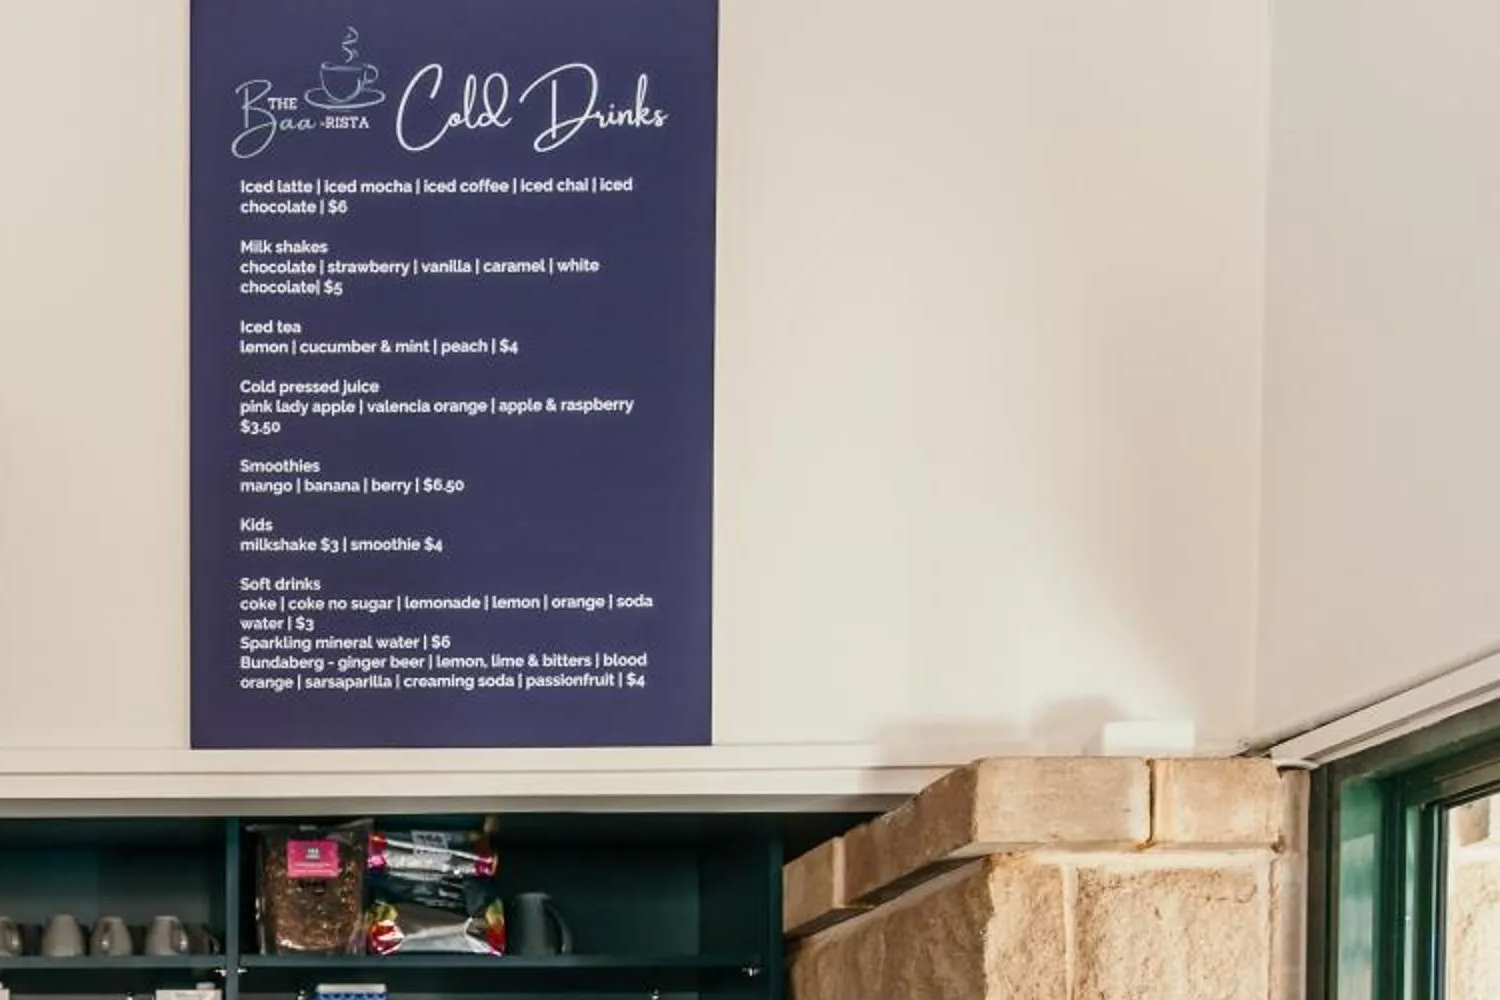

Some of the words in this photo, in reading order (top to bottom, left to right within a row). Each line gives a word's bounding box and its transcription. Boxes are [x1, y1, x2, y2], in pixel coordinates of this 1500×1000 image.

[267, 97, 298, 110] THE
[396, 63, 512, 151] Cold
[519, 63, 669, 153] Drinks
[240, 179, 275, 194] Iced
[276, 179, 314, 194] latte
[323, 179, 358, 194] iced
[359, 179, 413, 193] mocha
[423, 178, 458, 193] iced
[459, 178, 511, 193] coffee
[519, 177, 554, 193] iced
[555, 177, 590, 192] chai
[599, 177, 634, 192] iced
[239, 199, 318, 214] chocolate
[327, 198, 349, 215] $6
[240, 239, 273, 254] Milk
[275, 239, 329, 254] shakes
[238, 259, 317, 274] chocolate
[326, 259, 412, 277] strawberry
[419, 259, 474, 273] vanilla
[481, 258, 547, 273] caramel
[555, 257, 601, 272] white
[239, 320, 274, 334] Iced
[276, 320, 302, 334] tea
[239, 339, 289, 354] lemon
[298, 339, 378, 354] cucumber
[379, 339, 393, 353] &
[394, 339, 431, 353] mint
[440, 338, 489, 357] peach
[499, 337, 519, 355] $4
[239, 379, 277, 394] Cold
[278, 379, 341, 397] pressed
[340, 379, 381, 397] juice
[239, 418, 282, 435] $3.50
[239, 458, 322, 473] Smoothies
[239, 481, 294, 496] mango
[303, 478, 361, 493] banana
[370, 478, 413, 495] berry
[422, 477, 465, 494] $6.50
[239, 517, 274, 532] Kids
[239, 537, 318, 552] milkshake
[319, 536, 340, 553] $3
[349, 537, 422, 551] smoothie
[423, 536, 444, 552] $4
[239, 577, 273, 591] Soft
[273, 576, 322, 591] drinks
[239, 617, 285, 630] water
[294, 615, 315, 632] $3
[239, 636, 313, 653] Sparkling
[314, 635, 375, 649] mineral
[374, 636, 421, 649] water
[430, 634, 452, 649] $6
[239, 677, 295, 693] orange
[304, 674, 394, 692] sarsaparilla
[402, 674, 476, 691] creaming
[476, 673, 516, 687] soda
[524, 672, 616, 690] passionfruit
[625, 671, 647, 688] $4
